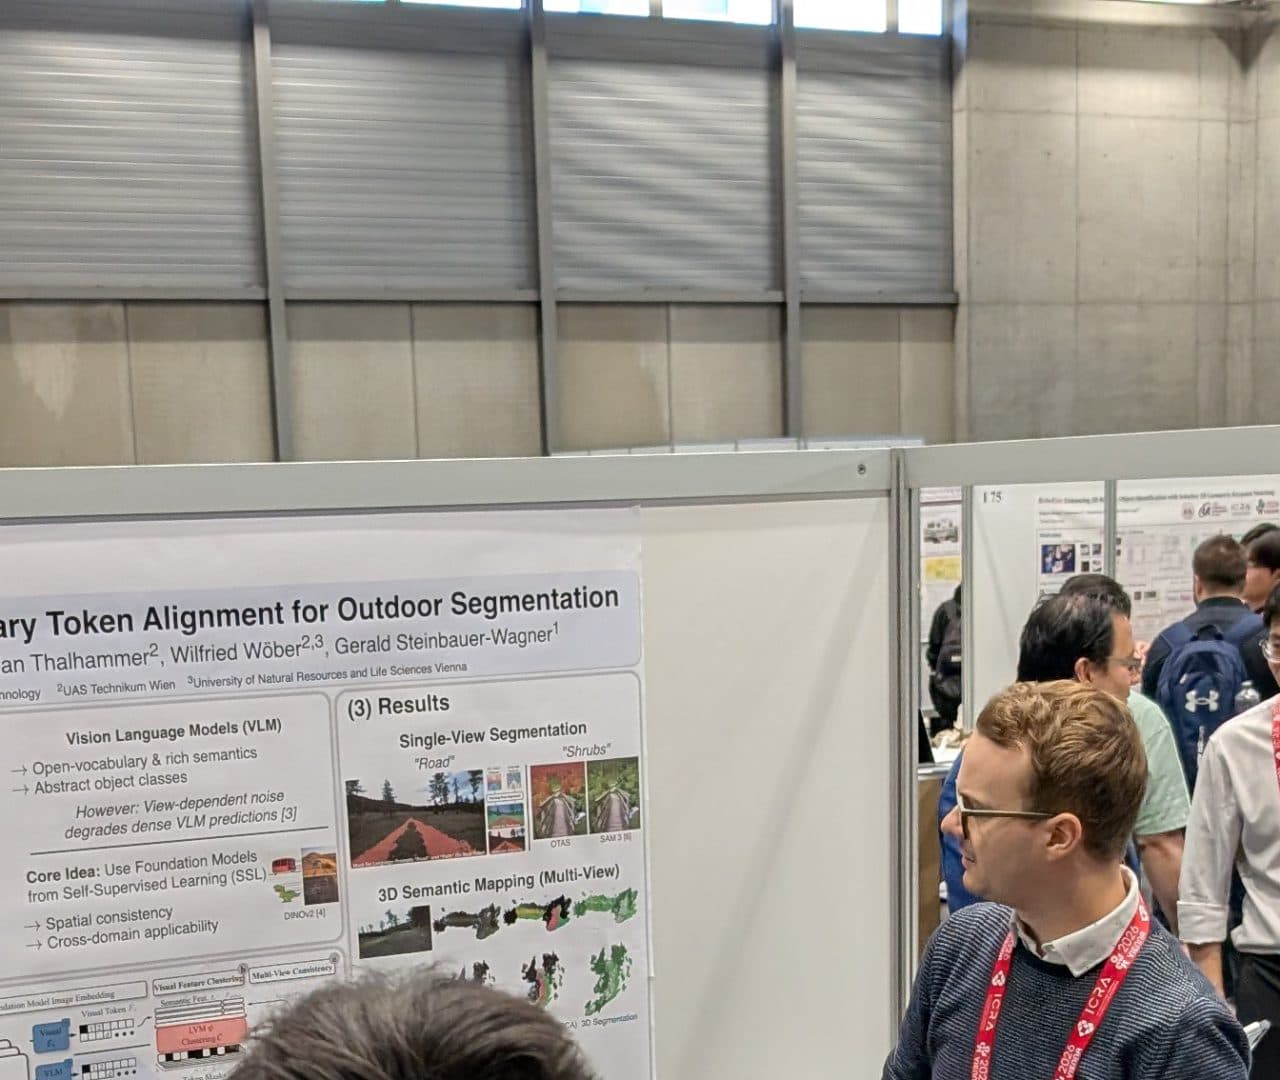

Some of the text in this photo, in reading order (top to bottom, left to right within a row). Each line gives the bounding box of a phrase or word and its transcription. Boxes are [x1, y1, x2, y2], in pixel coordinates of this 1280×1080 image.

[46, 609, 133, 636] Token
[143, 602, 284, 636] Alignment
[292, 600, 329, 623] for
[338, 594, 443, 621] Outdoor
[451, 585, 618, 619] Segmentation
[170, 643, 237, 663] Wilfried
[335, 635, 390, 654] Gerald
[90, 682, 146, 694] Technikum
[149, 680, 175, 690] Wien
[246, 674, 254, 685] of
[258, 672, 294, 684] Natural
[297, 671, 348, 682] Resources
[350, 667, 368, 678] and
[370, 666, 387, 676] Life
[390, 664, 432, 675] Sciences
[434, 663, 467, 672] Vienna
[348, 694, 450, 722] (3) Results
[66, 718, 281, 745] Vision Language Models (VLM)
[400, 722, 586, 750] Single-View Segmentation
[33, 747, 257, 777] Open-vocabulary & rich semantics
[378, 864, 619, 902] 3D Semantic Mapping (Multi-View)
[1117, 925, 1139, 952] 2026
[1084, 977, 1111, 1015] ICRA
[985, 993, 1001, 1031] ICRA
[1058, 1044, 1076, 1074] 2026
